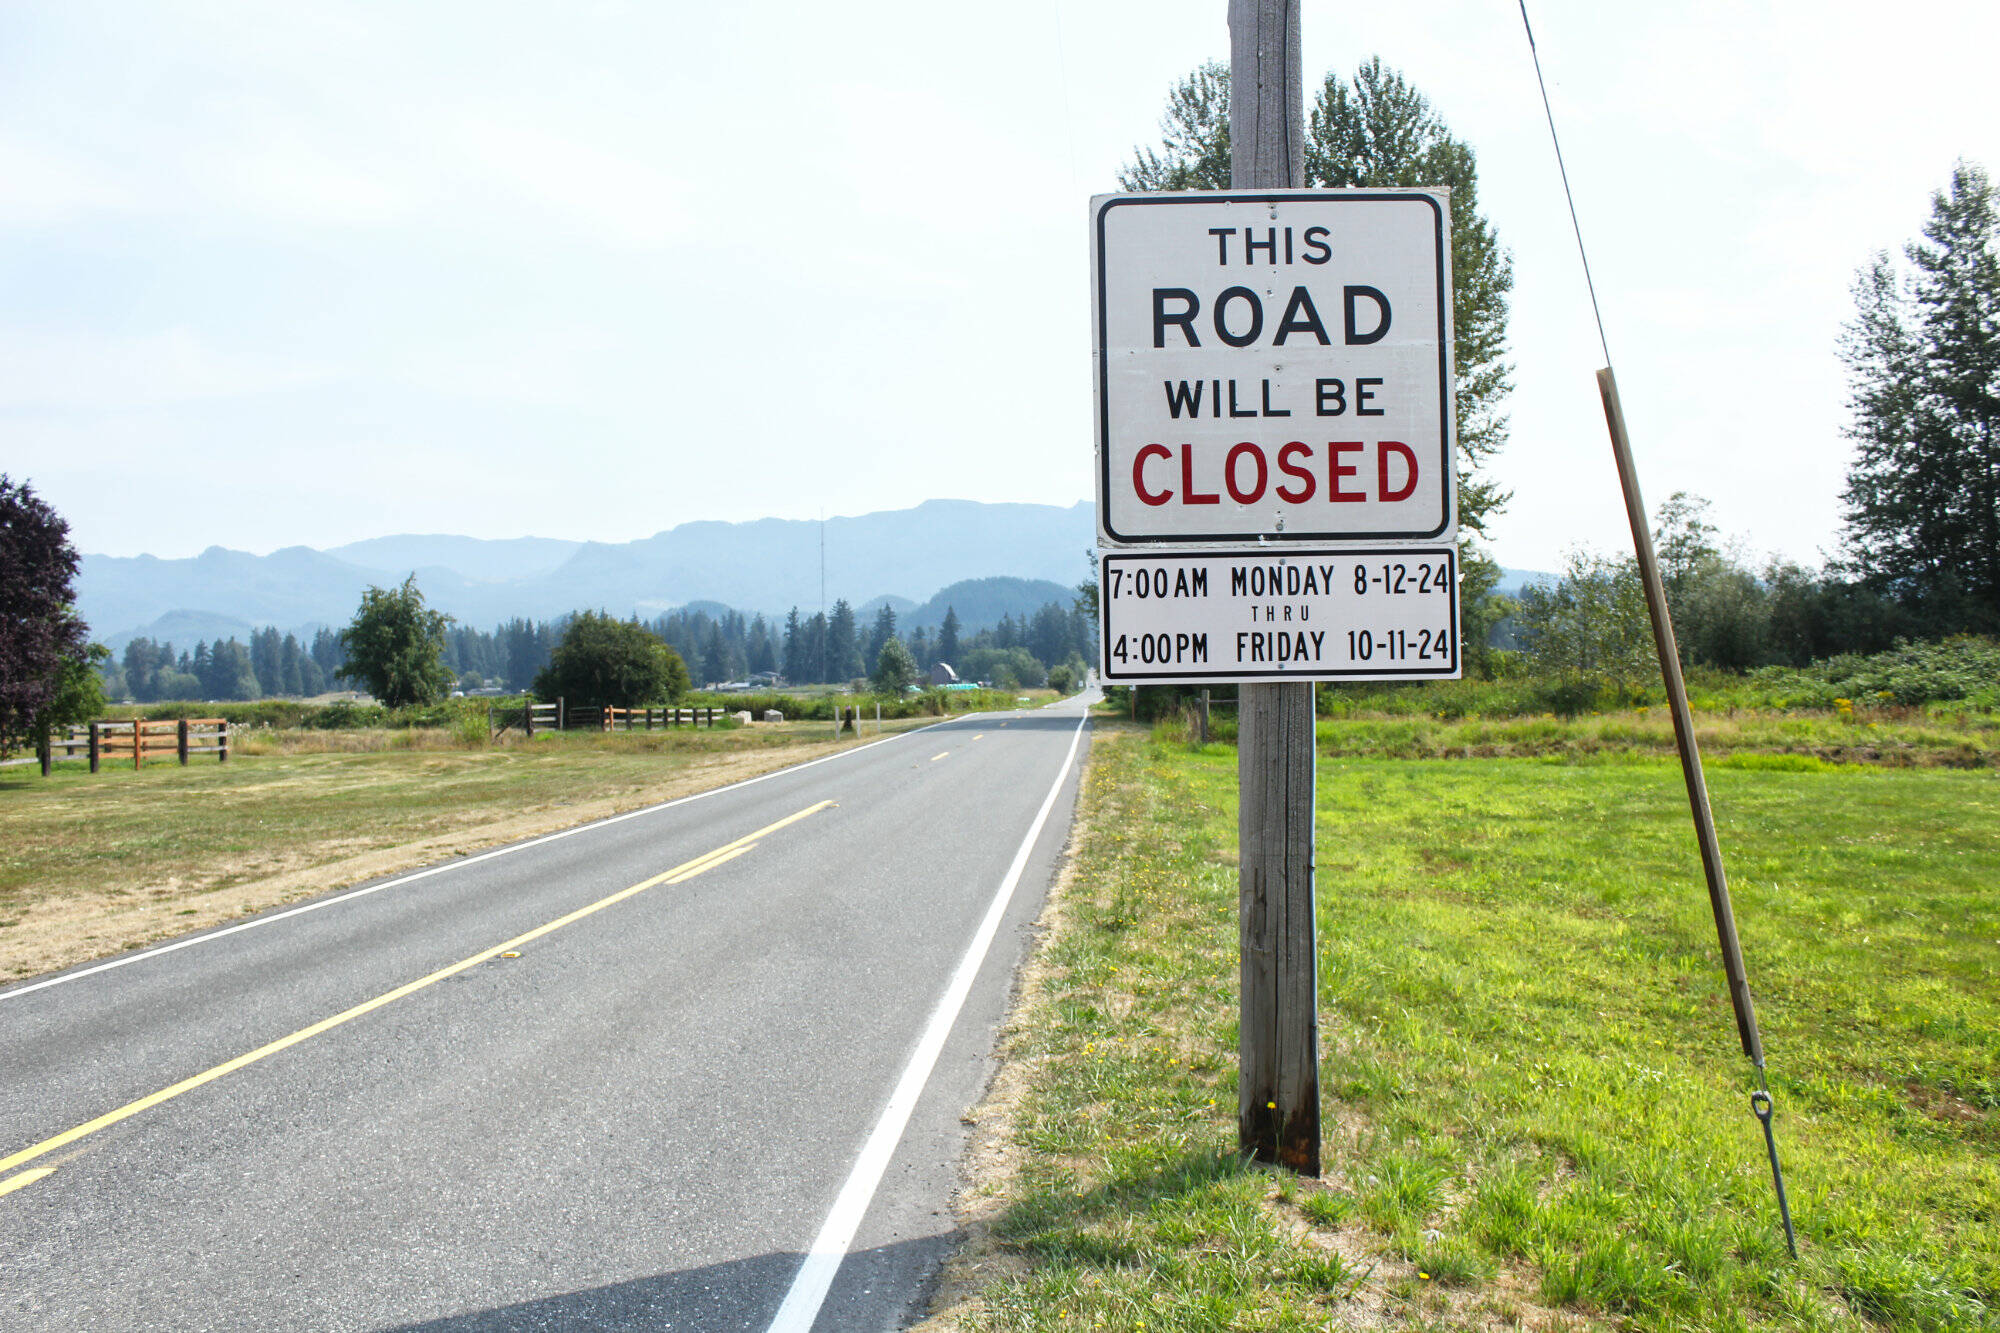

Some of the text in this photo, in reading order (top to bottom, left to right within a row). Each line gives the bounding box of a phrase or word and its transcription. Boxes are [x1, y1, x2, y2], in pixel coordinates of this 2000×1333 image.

[1209, 227, 1331, 265] THIS
[1153, 285, 1392, 348] ROAD
[1164, 378, 1384, 419] WILL BE
[1133, 441, 1418, 506] CLOSED
[1232, 566, 1334, 596] MONDAY
[1354, 564, 1448, 595] 8-12-24
[1252, 605, 1309, 622] THRU
[1237, 631, 1325, 662] FRIDAY
[1348, 629, 1448, 660] 10-11-24
